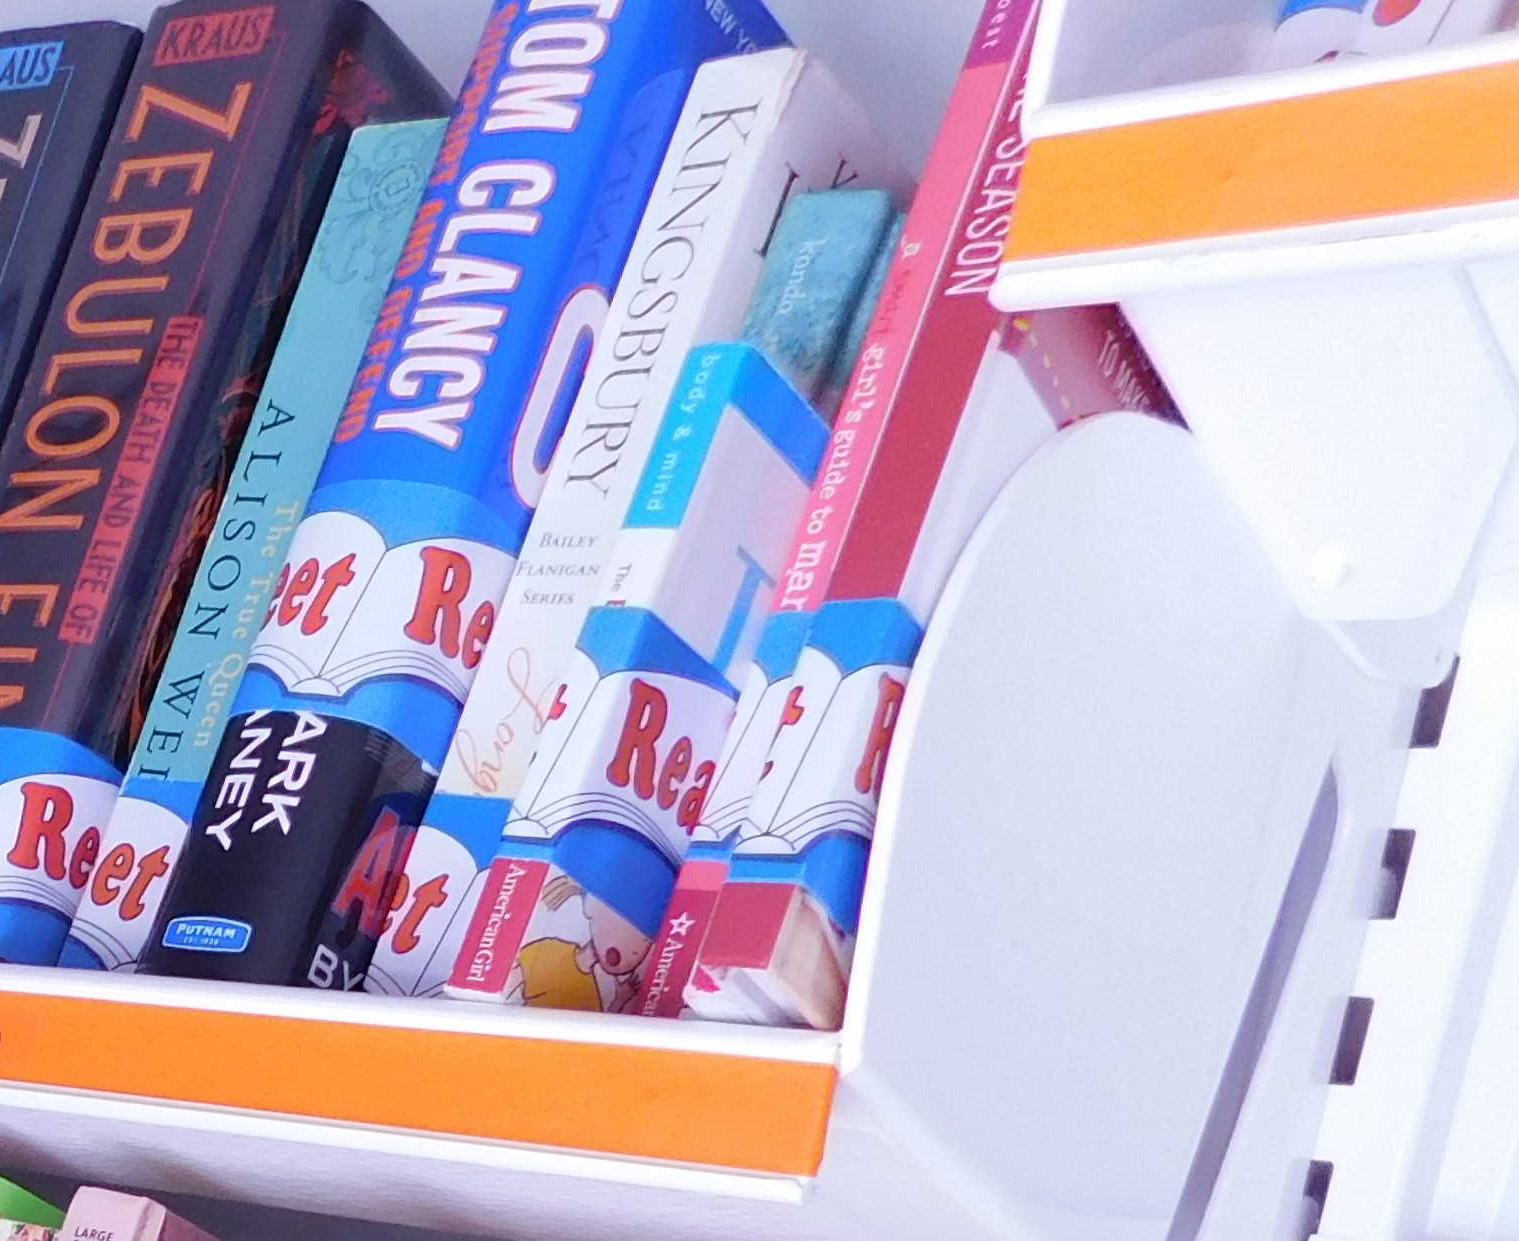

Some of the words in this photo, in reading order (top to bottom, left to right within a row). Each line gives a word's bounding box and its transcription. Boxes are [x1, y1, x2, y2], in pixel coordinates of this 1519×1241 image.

[162, 14, 266, 60] KRAUS
[481, 0, 624, 133] TOM
[372, 160, 556, 451] CLANCY
[561, 102, 760, 499] KINGSBURY
[775, 237, 828, 316] kondo
[680, 352, 722, 415] body
[644, 451, 678, 511] mind
[818, 429, 857, 501] guide
[186, 398, 297, 643] ALISON
[258, 501, 300, 559] The
[538, 532, 600, 549] BAILEY
[805, 504, 836, 534] to
[516, 561, 601, 579] FLANIGAN
[519, 590, 576, 606] SERIES
[230, 574, 273, 640] True
[192, 650, 247, 750] Queen
[174, 923, 238, 940] PUTNAM
